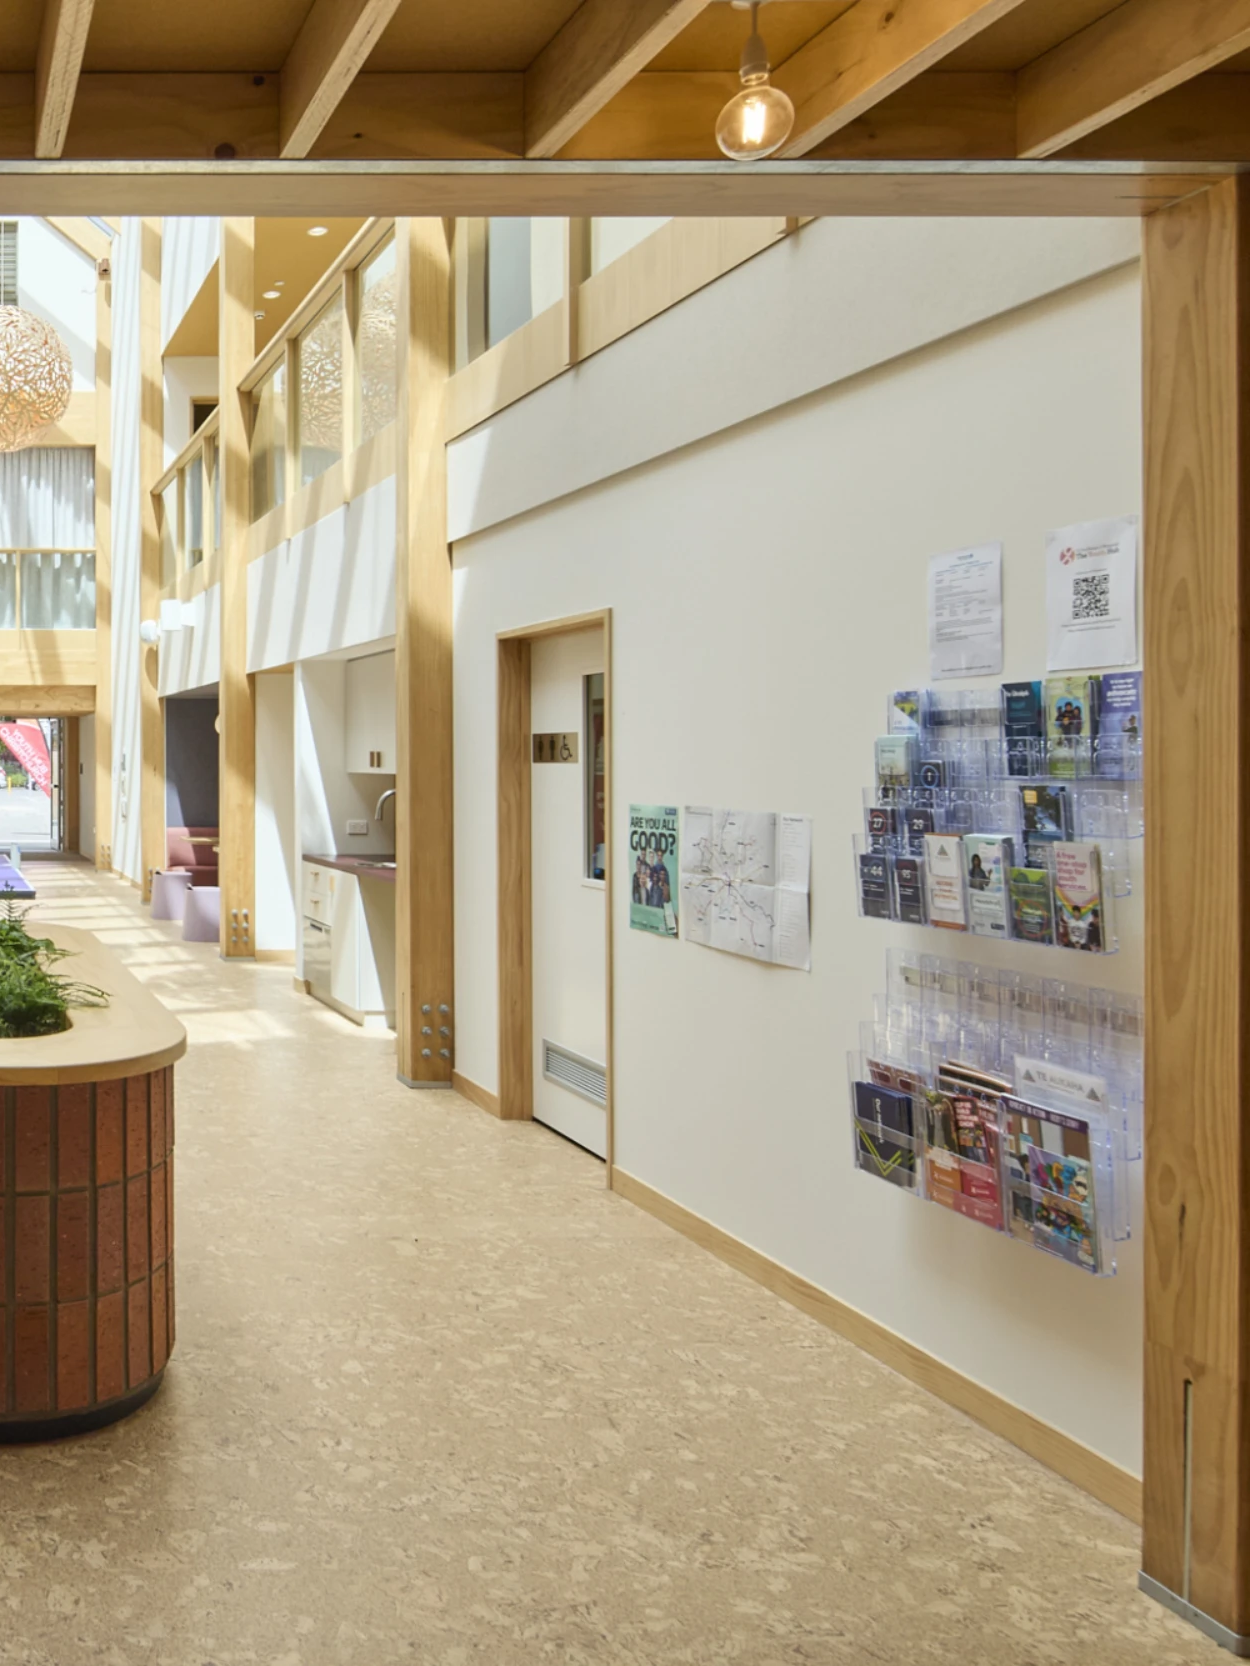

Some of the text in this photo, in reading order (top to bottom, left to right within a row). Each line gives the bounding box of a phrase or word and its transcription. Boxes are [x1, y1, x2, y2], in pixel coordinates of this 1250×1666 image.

[12, 728, 49, 774] YOUTH HUB
[630, 816, 676, 832] ARE YOU ALL
[913, 818, 924, 831] 29
[630, 829, 676, 856] GOOD?
